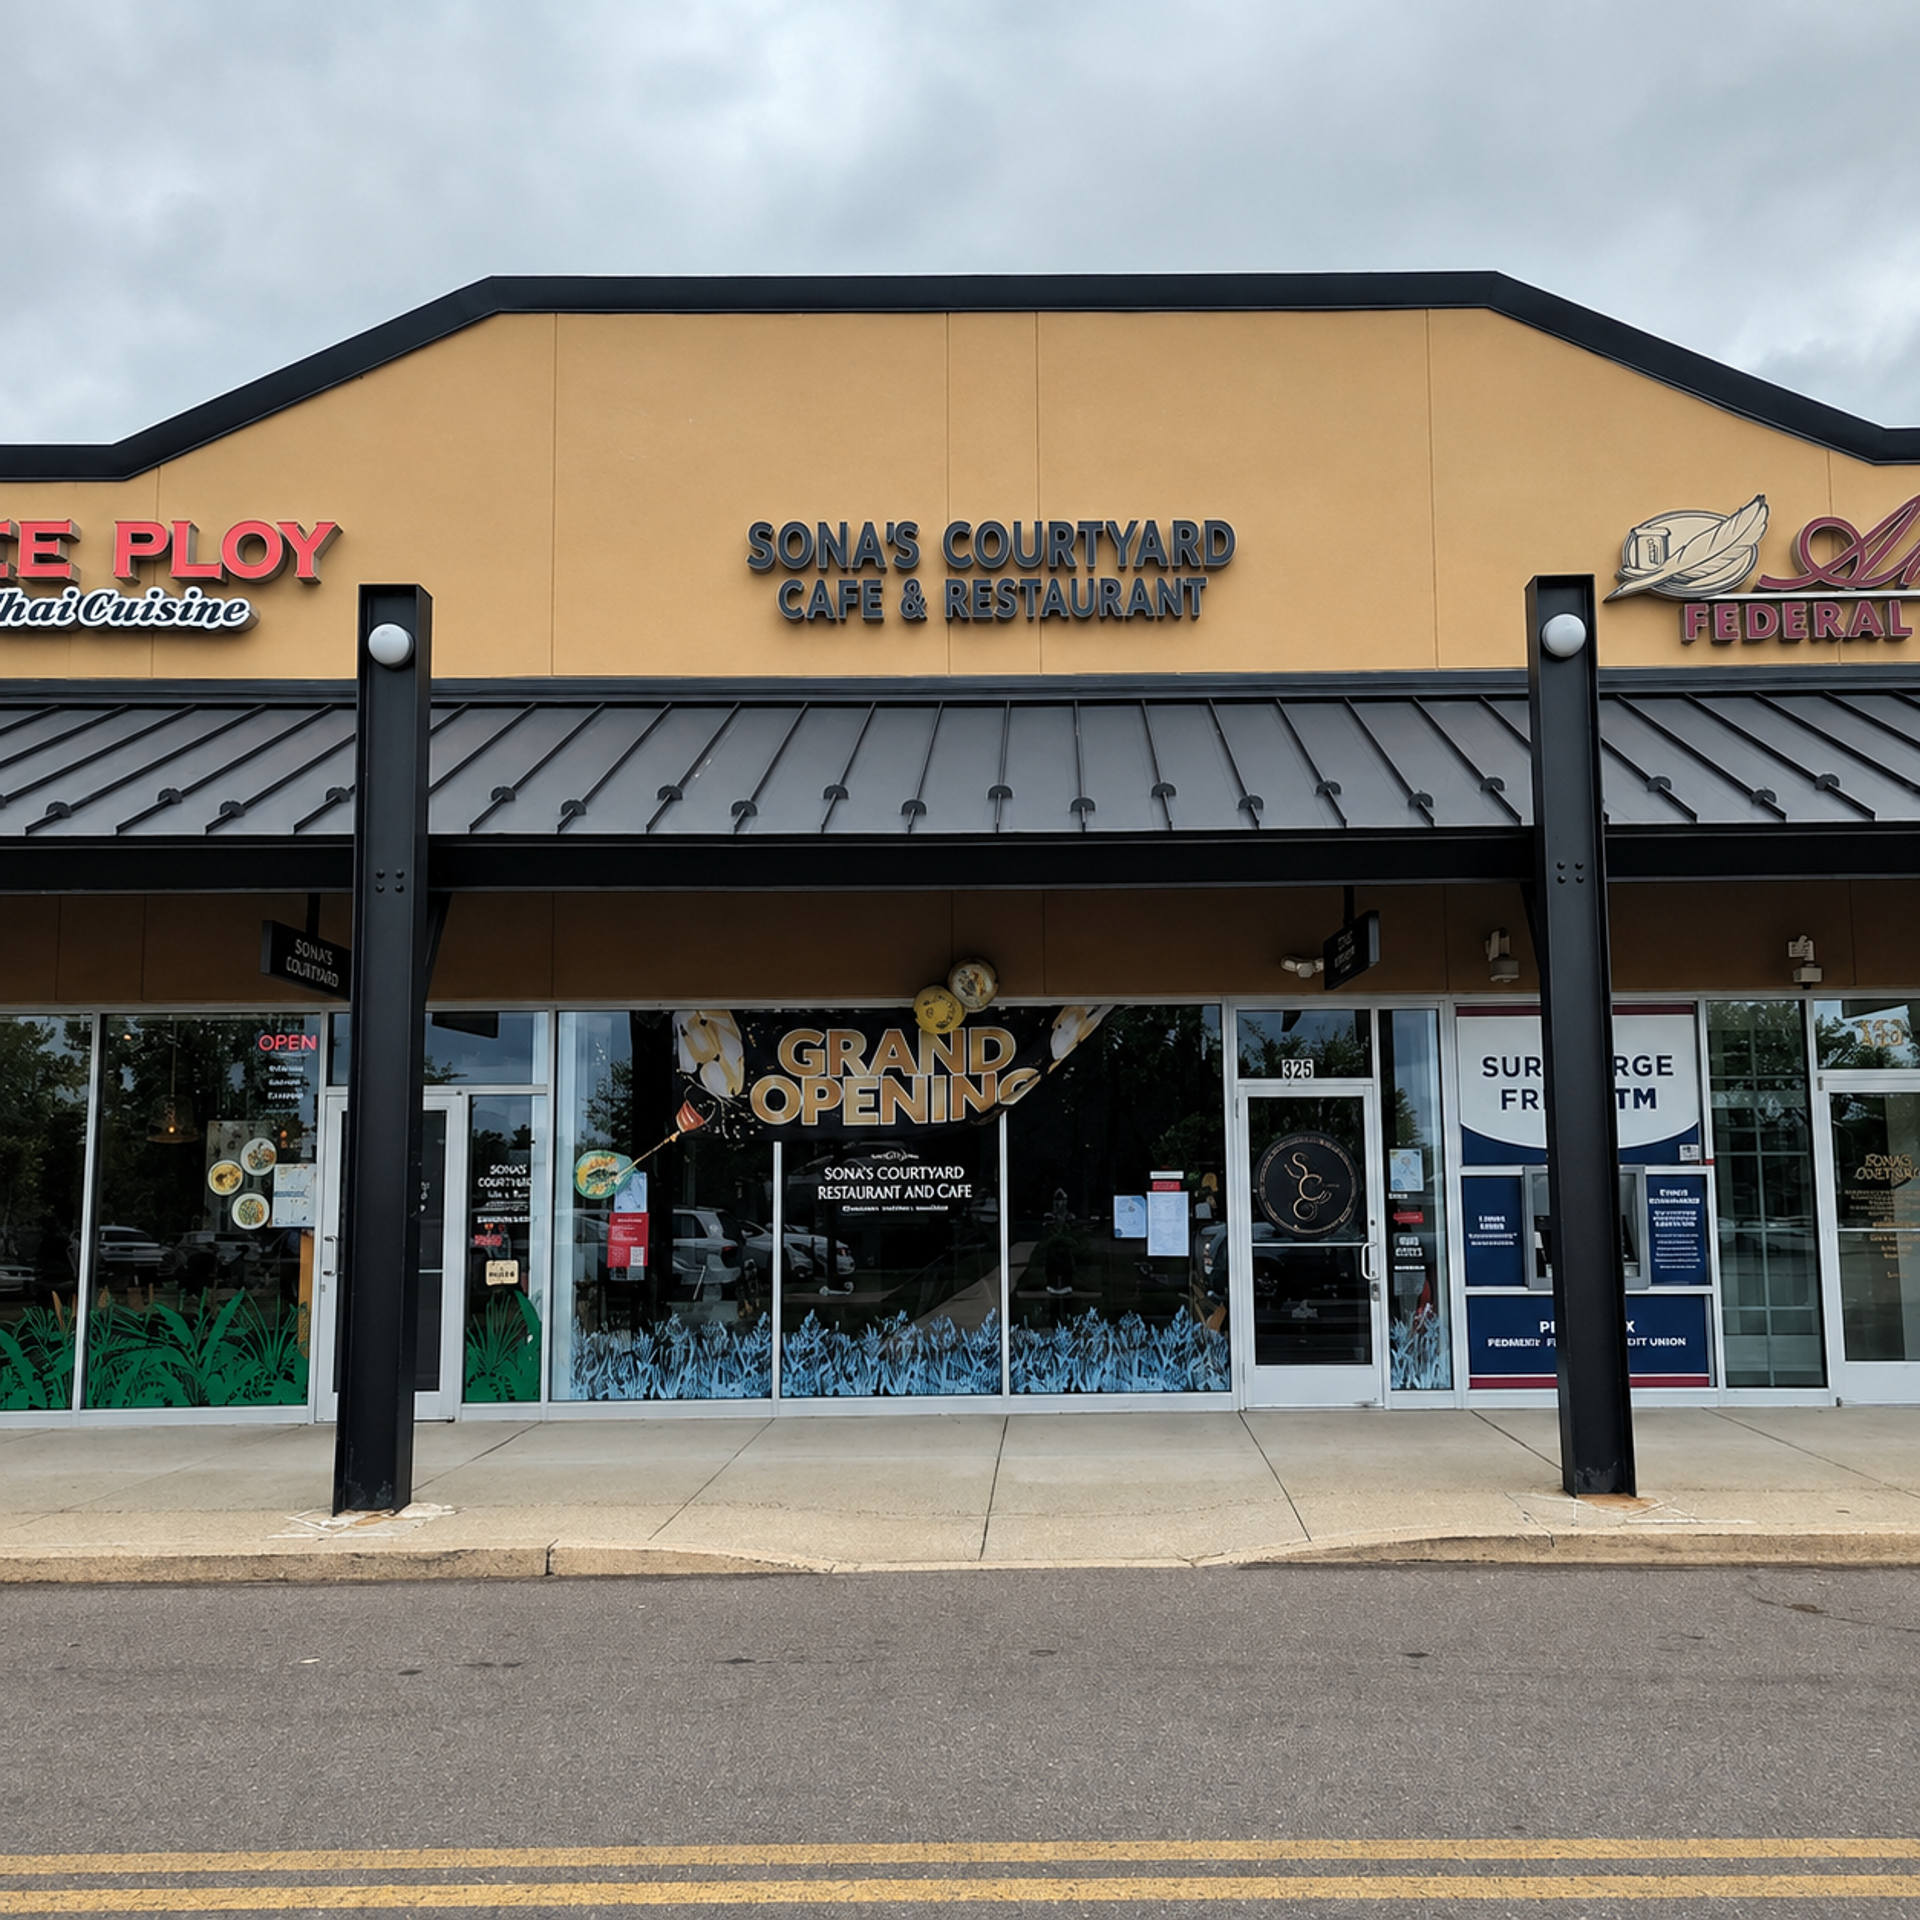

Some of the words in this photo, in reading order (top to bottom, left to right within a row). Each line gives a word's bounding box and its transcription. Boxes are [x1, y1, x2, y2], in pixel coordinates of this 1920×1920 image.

[0, 518, 78, 582] E
[112, 518, 341, 583] PLOY
[746, 520, 920, 570] SONA'S
[942, 519, 1237, 570] COURTYARD
[0, 587, 77, 627] hai
[78, 586, 251, 629] Cuisine
[776, 578, 884, 620] CAFE
[899, 578, 927, 620] &
[943, 576, 1209, 620] RESTAURANT
[1682, 600, 1913, 641] FEDERAL
[258, 1034, 318, 1051] OPEN
[777, 1027, 1017, 1078] GRAND
[1283, 1060, 1313, 1079] 325
[1481, 1055, 1675, 1078] SURRGE
[1500, 1088, 1545, 1111] FR
[1614, 1088, 1658, 1110] TM
[823, 1166, 875, 1181] SONA'S
[877, 1166, 965, 1181] COURTYARD
[817, 1184, 902, 1200] RESTAURANT
[904, 1184, 935, 1200] AND
[936, 1183, 973, 1199] CAFE
[1648, 1337, 1687, 1347] UNION
